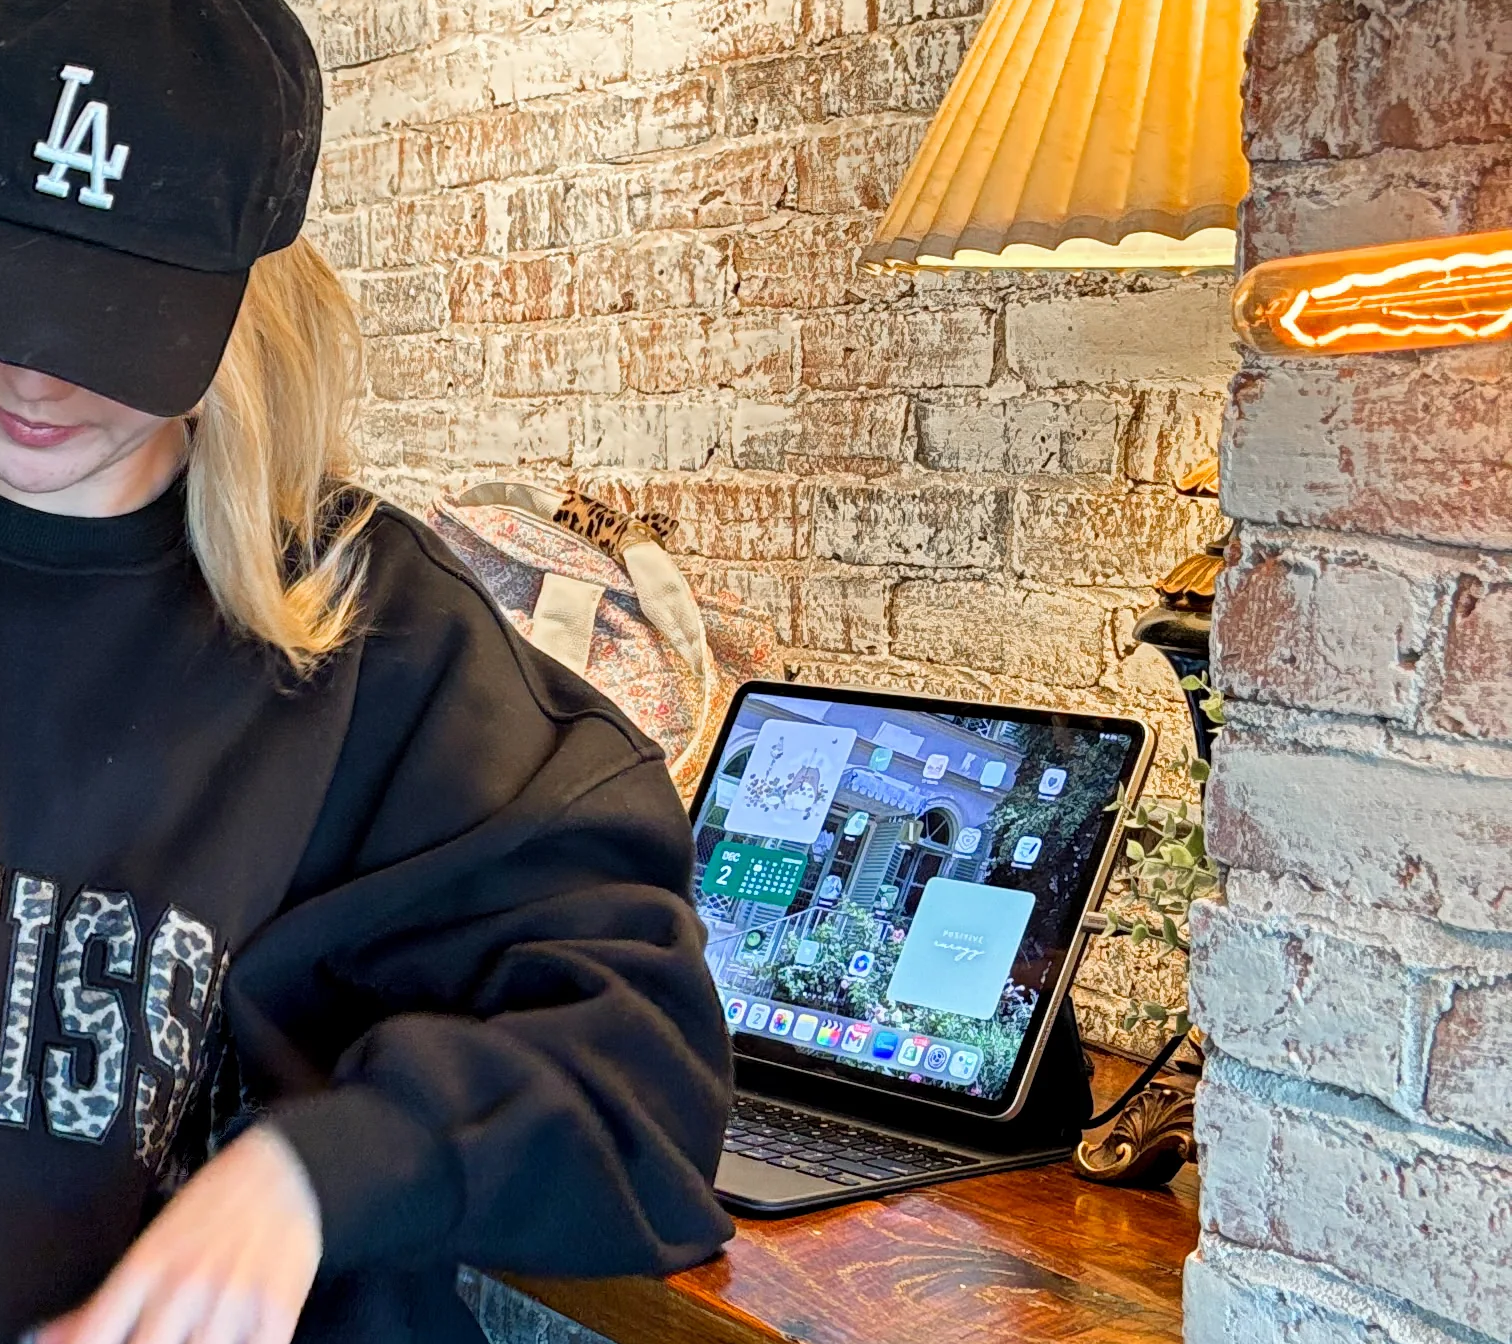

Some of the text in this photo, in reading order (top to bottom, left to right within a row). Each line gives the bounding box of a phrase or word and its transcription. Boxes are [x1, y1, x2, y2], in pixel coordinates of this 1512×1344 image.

[34, 64, 130, 210] LA
[721, 850, 741, 863] DEC
[716, 865, 732, 885] 2
